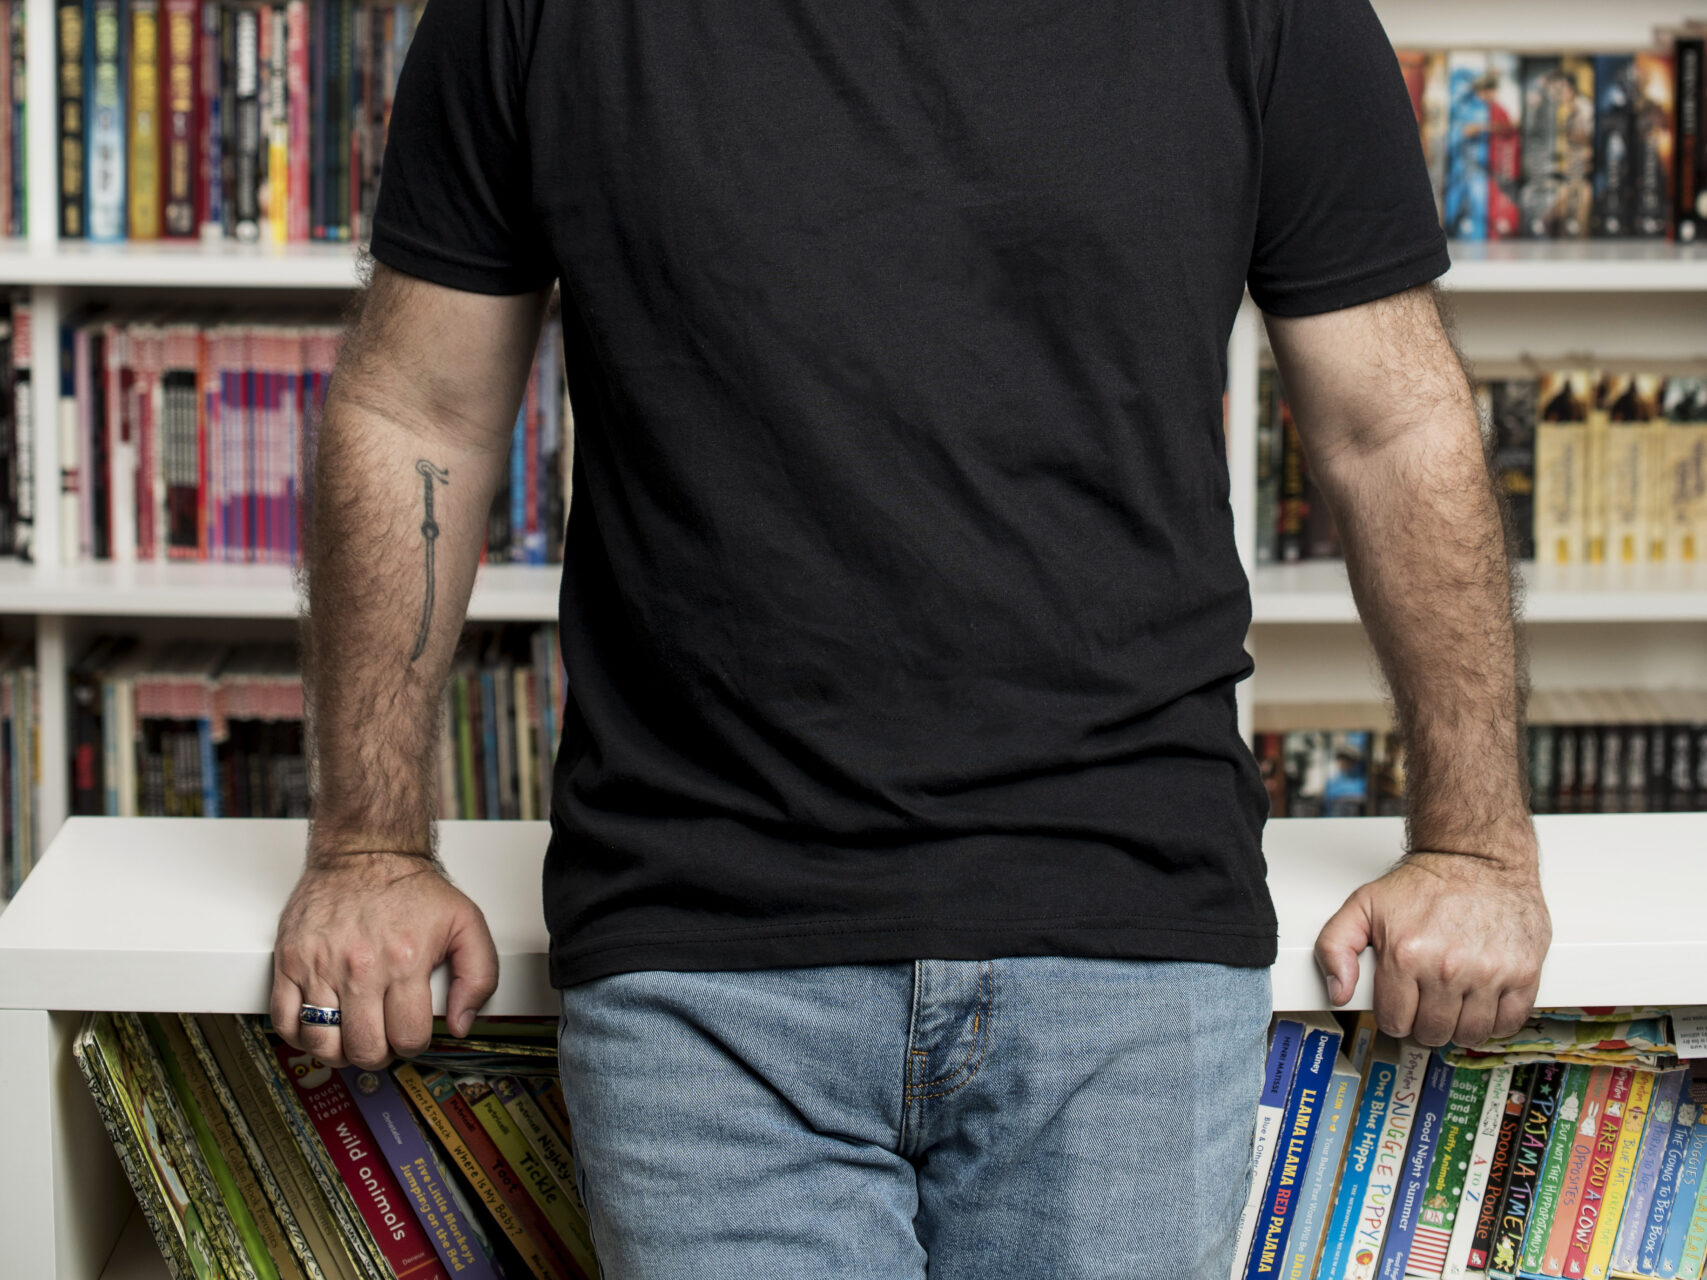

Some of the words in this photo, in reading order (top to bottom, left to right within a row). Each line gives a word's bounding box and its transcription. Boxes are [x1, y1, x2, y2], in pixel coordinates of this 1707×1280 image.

[1279, 1036, 1291, 1063] HENRI
[1310, 1035, 1328, 1074] Dewdney
[309, 1083, 341, 1102] touch
[1271, 1062, 1284, 1094] MATISSE
[1374, 1070, 1392, 1097] One
[1452, 1080, 1478, 1093] Baby
[313, 1093, 346, 1111] think
[405, 1078, 428, 1105] Ziefert
[429, 1111, 451, 1139] Taback
[1334, 1081, 1347, 1110] FALLON
[1449, 1090, 1477, 1103] Touch
[1450, 1103, 1470, 1113] and
[317, 1102, 350, 1120] learn
[1261, 1116, 1271, 1135] Blue
[1292, 1089, 1317, 1136] LLAMA
[1366, 1100, 1385, 1129] Blue
[1447, 1112, 1469, 1125] Feel
[1376, 1091, 1415, 1177] SNUGGLE
[1420, 1112, 1436, 1142] Good
[1443, 1126, 1459, 1153] Fluffy
[1513, 1096, 1555, 1179] PAJAMA
[1557, 1122, 1571, 1141] BUT
[1597, 1120, 1618, 1154] ARE
[1648, 1125, 1667, 1157] HORNS
[1672, 1129, 1688, 1149] THE
[1322, 1137, 1334, 1155] Your
[1354, 1132, 1377, 1172] Hippo
[1411, 1144, 1429, 1177] Night
[1473, 1155, 1488, 1166] A
[1489, 1121, 1517, 1182] Spooky
[1553, 1144, 1565, 1162] NOT
[1621, 1138, 1635, 1163] BLUE
[1684, 1131, 1707, 1184] DOGGIES
[492, 1160, 518, 1193] Toot
[1280, 1138, 1304, 1186] LLAMA
[1436, 1153, 1452, 1191] Animals
[1550, 1165, 1562, 1183] THE
[1563, 1144, 1587, 1207] OPPOSITES
[1589, 1156, 1610, 1188] YOU
[1612, 1166, 1629, 1187] HAT,
[1644, 1160, 1654, 1169] TO
[1662, 1150, 1683, 1182] GOING
[336, 1122, 368, 1161] wild
[359, 1167, 406, 1241] animals
[454, 1146, 478, 1178] Where
[477, 1179, 487, 1189] Is
[484, 1188, 496, 1204] My
[495, 1204, 523, 1236] Baby?
[520, 1151, 558, 1204] Tickle
[1472, 1173, 1482, 1186] TO
[1638, 1172, 1654, 1192] TOES
[1659, 1186, 1671, 1197] TO
[228, 1147, 248, 1181] Golden
[245, 1183, 260, 1207] Book
[257, 1208, 280, 1248] Favorites
[1273, 1188, 1291, 1215] RED
[1399, 1181, 1420, 1231] Summer
[1466, 1190, 1481, 1203] Z
[1585, 1188, 1601, 1201] A
[400, 1164, 431, 1213] Jumping
[427, 1213, 440, 1228] on
[436, 1228, 451, 1249] the
[446, 1248, 466, 1272] Bed
[414, 1157, 431, 1182] Five
[427, 1182, 447, 1213] Little
[444, 1212, 476, 1264] Monkeys
[1305, 1202, 1318, 1224] Word
[1358, 1184, 1391, 1248] PUPPY!
[1477, 1186, 1502, 1240] Pookie
[1501, 1182, 1532, 1241] TIME!
[1529, 1184, 1557, 1255] HIPPOPOTAMUS
[1604, 1192, 1623, 1228] GREEN
[1654, 1200, 1670, 1222] BED
[1301, 1225, 1312, 1240] Will
[1572, 1204, 1597, 1254] COW?
[1600, 1228, 1613, 1246] HAT
[1645, 1225, 1662, 1254] BOOK
[1258, 1216, 1284, 1273] PAJAMA
[1298, 1241, 1307, 1252] Be
